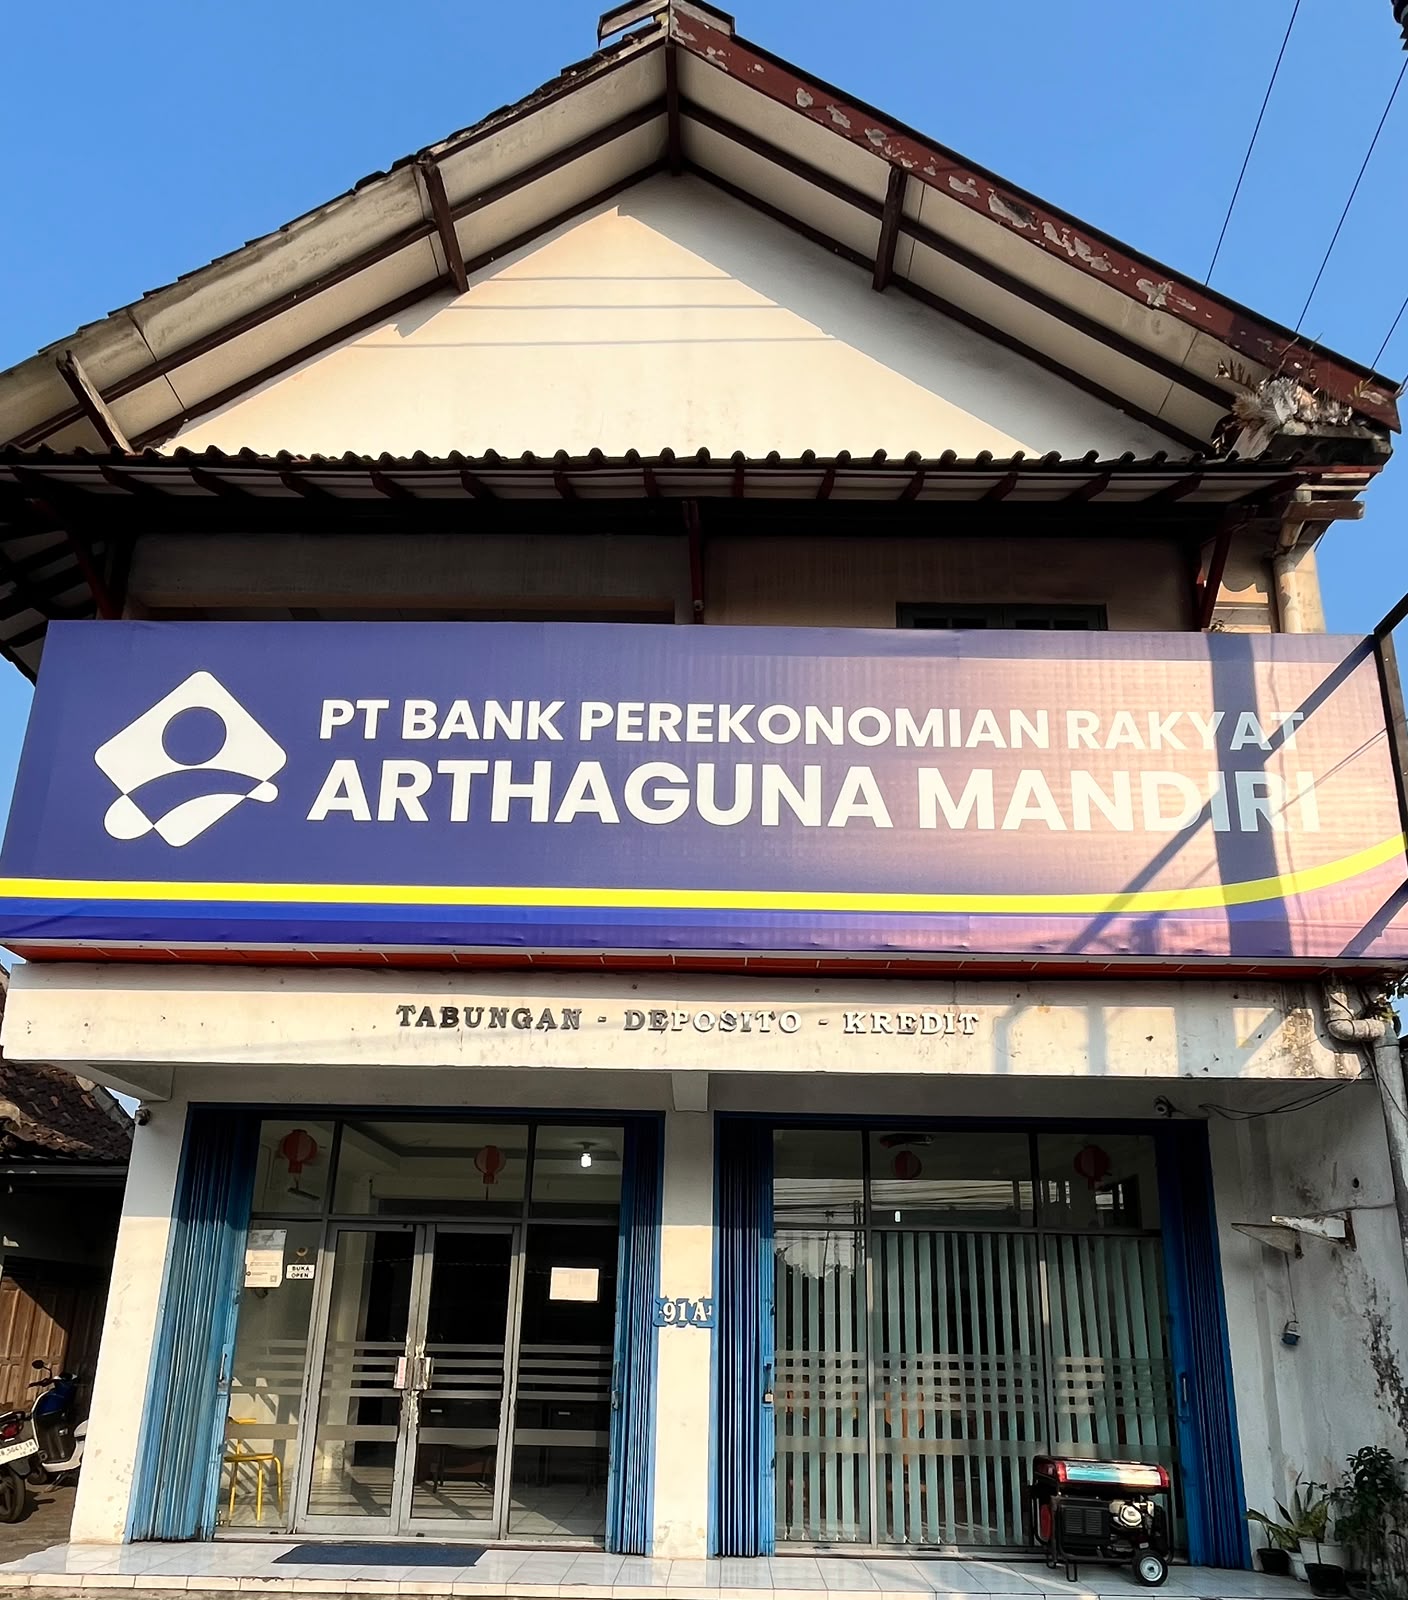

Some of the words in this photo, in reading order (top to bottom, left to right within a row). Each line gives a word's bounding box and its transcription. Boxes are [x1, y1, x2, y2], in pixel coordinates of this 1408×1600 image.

[319, 699, 389, 739] PT
[401, 700, 565, 741] BANK
[578, 702, 1051, 749] PEREKONOMIAN
[1066, 710, 1304, 752] RAKYAT
[307, 758, 894, 829] ARTHAGUNA
[917, 767, 1319, 833] MANDIRI
[396, 1005, 582, 1030] TABUNGAN
[623, 1009, 801, 1033] DEPOSITO
[842, 1011, 979, 1035] KREDIT
[663, 1302, 708, 1323] 91A
